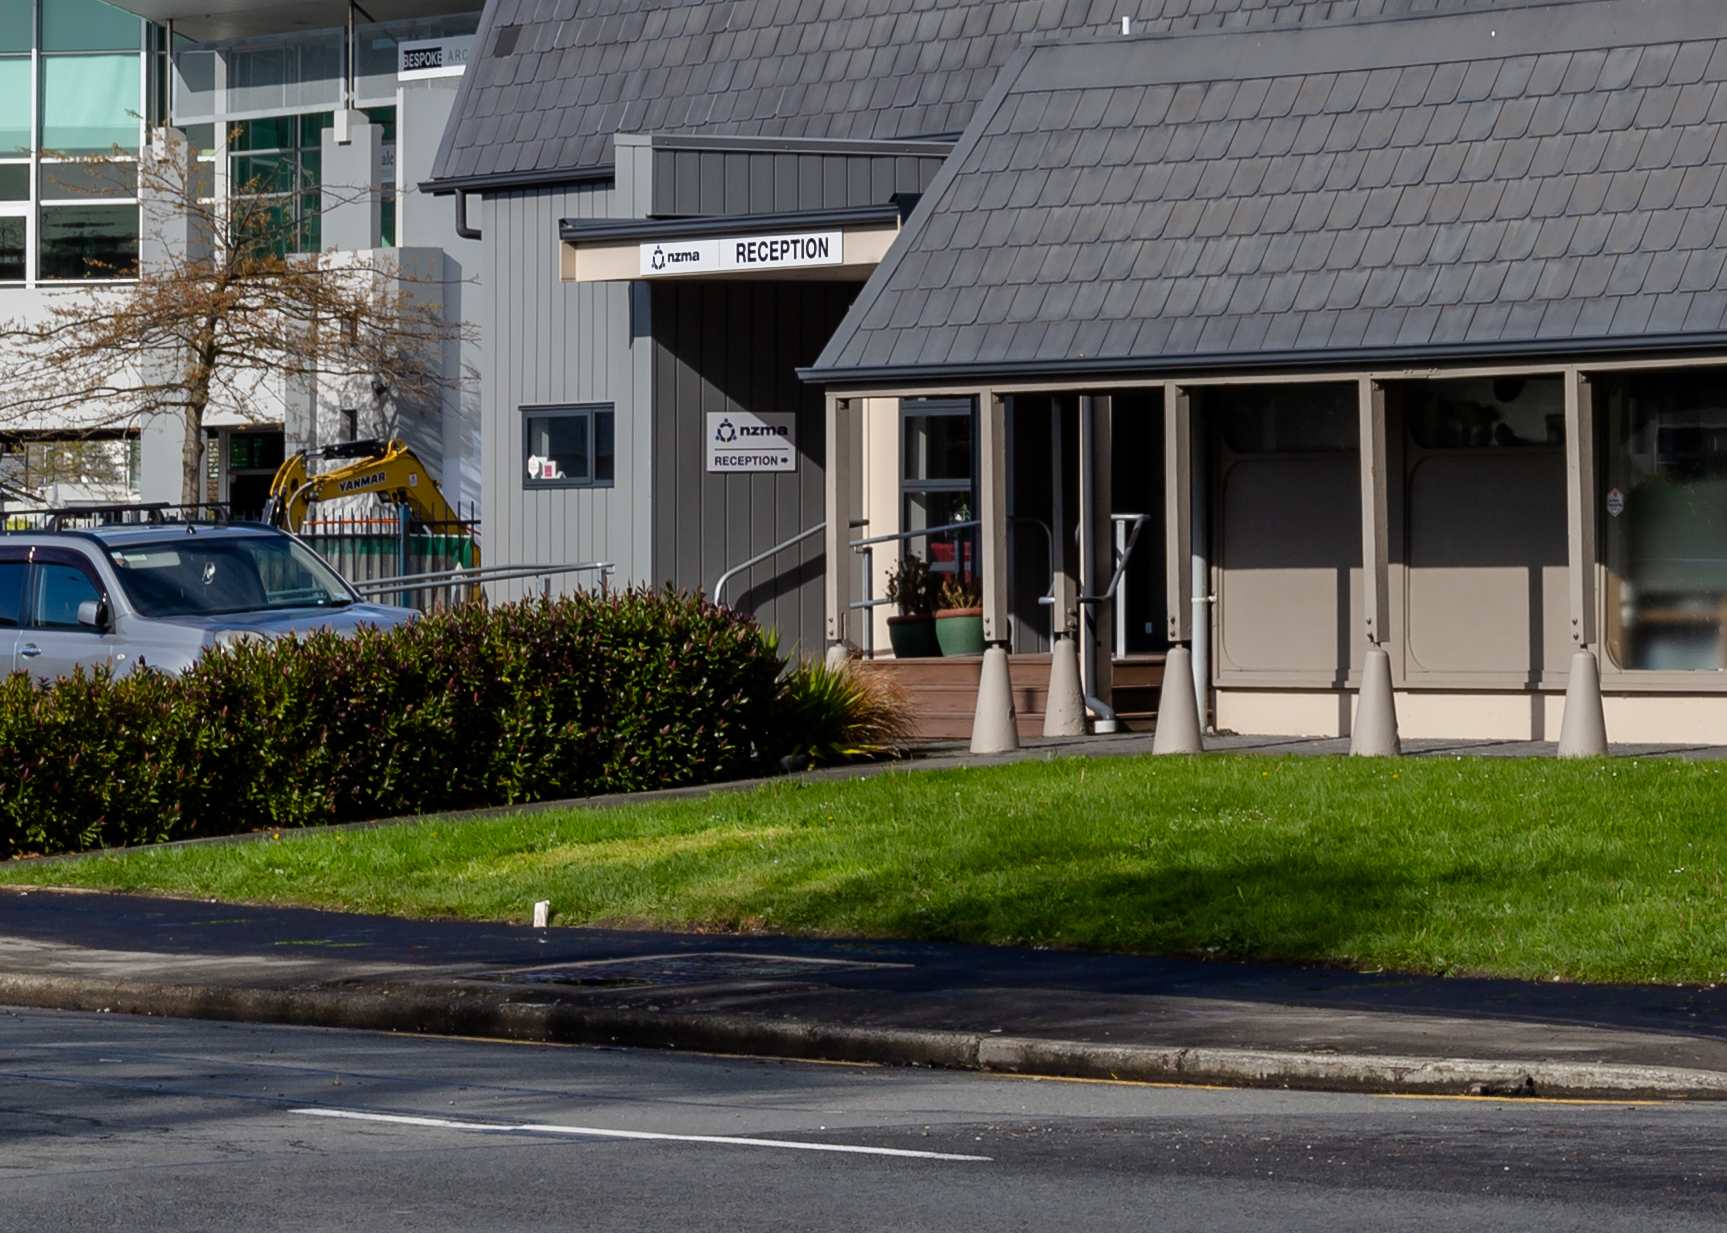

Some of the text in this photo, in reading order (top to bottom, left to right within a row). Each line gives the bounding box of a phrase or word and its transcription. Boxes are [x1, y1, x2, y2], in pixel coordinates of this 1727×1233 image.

[404, 50, 442, 68] BESPOKE
[667, 237, 829, 264] nzma RECEPTION
[740, 425, 789, 437] nzma
[714, 455, 778, 466] RECEPTION
[339, 471, 386, 493] YANMAR
